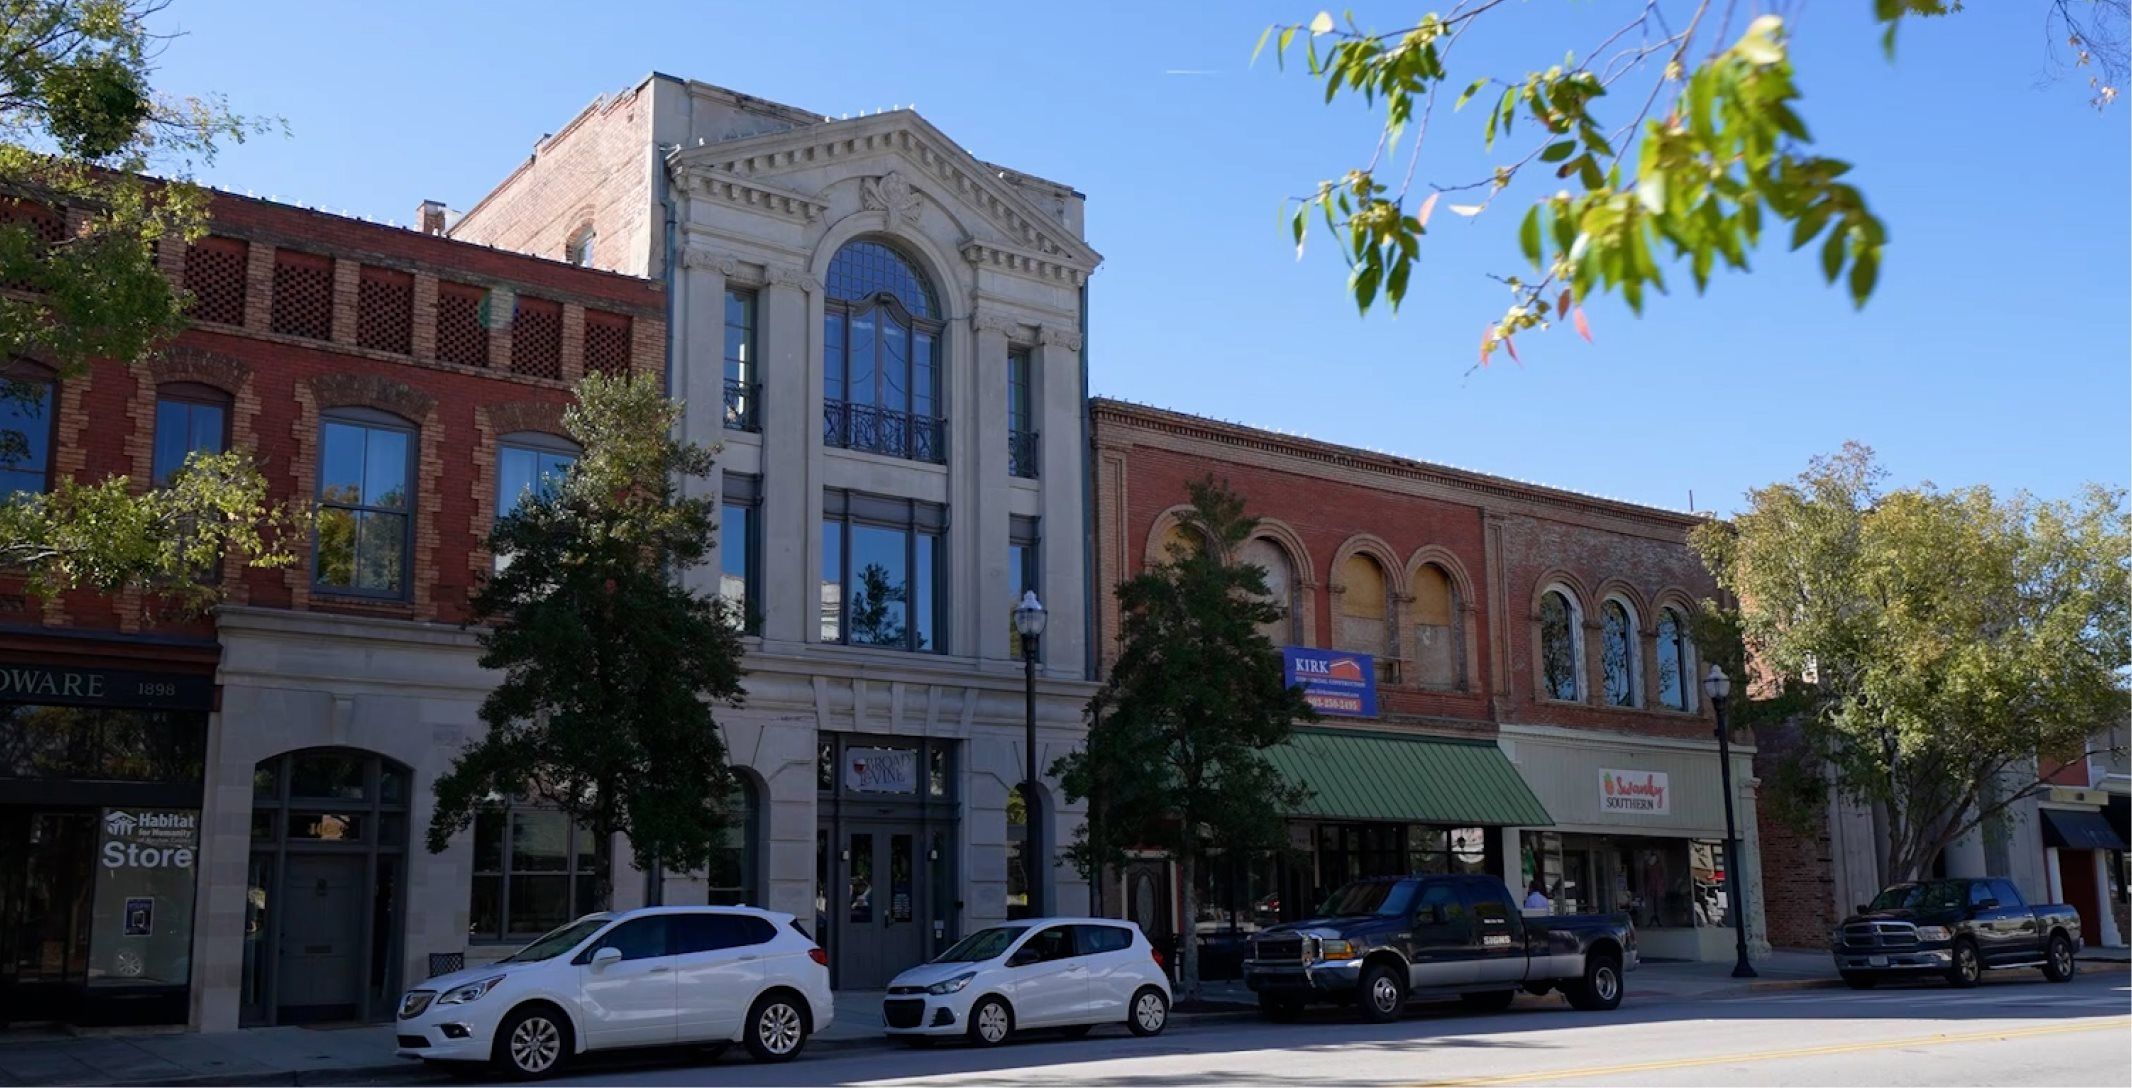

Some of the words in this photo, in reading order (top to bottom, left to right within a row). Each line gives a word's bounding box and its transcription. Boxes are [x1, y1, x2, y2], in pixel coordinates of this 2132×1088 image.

[1295, 658, 1328, 673] KIRK
[138, 682, 176, 697] 1898
[871, 768, 905, 784] VINE
[1616, 774, 1665, 808] Swanky
[1606, 797, 1654, 810] SOUTHERN
[139, 812, 194, 828] Habitat
[102, 840, 193, 868] Store
